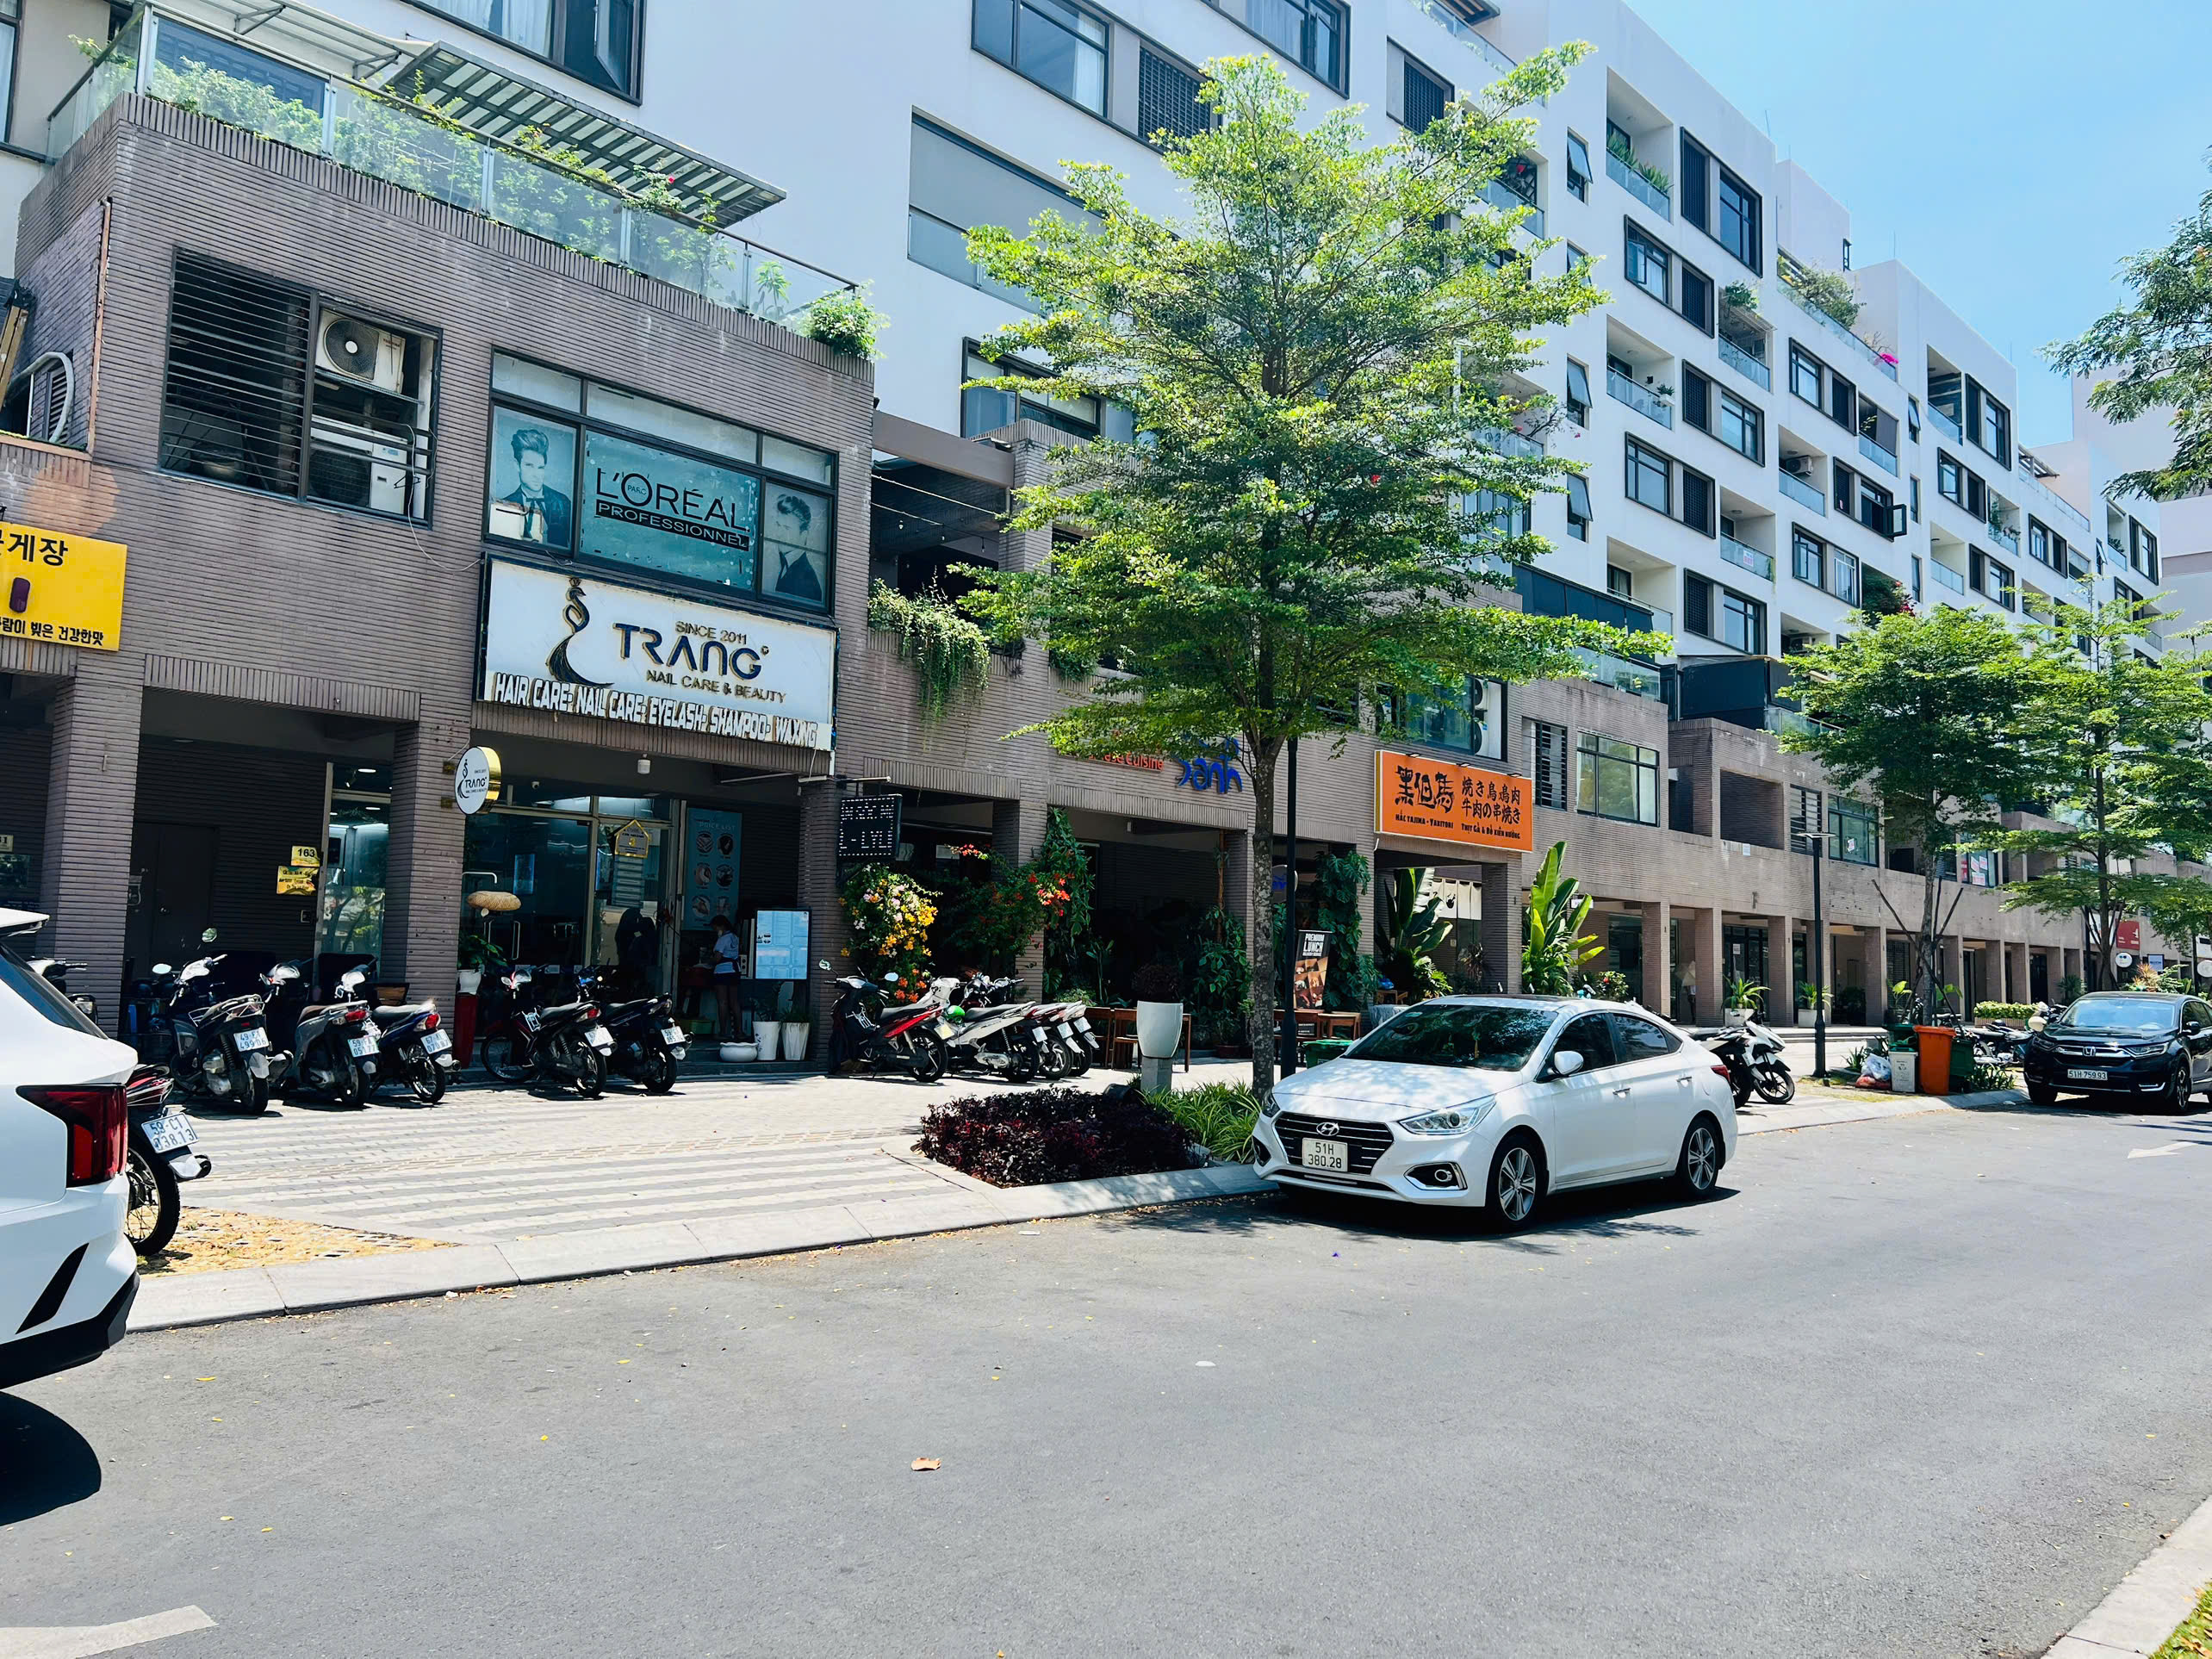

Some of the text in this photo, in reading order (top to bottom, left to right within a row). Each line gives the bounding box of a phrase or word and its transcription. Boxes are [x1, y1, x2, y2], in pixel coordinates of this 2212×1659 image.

[598, 502, 747, 548] PROFESSIONNEL
[58, 625, 104, 646] 건강한맛
[675, 620, 748, 645] SINCE 2011
[612, 623, 762, 680] TRANG
[647, 669, 786, 704] NAIL CARE & BEAUTY
[494, 672, 530, 706] HAIR
[575, 687, 606, 718] NAIL
[774, 716, 818, 749] WAXING
[1126, 751, 1165, 772] Cuisine
[465, 778, 486, 789] TRANG
[1430, 818, 1454, 829] YAKITORI
[298, 848, 315, 857] 163
[1303, 941, 1324, 953] LUNCH
[1315, 1142, 1334, 1155] 51H
[1308, 1153, 1342, 1169] 380.28
